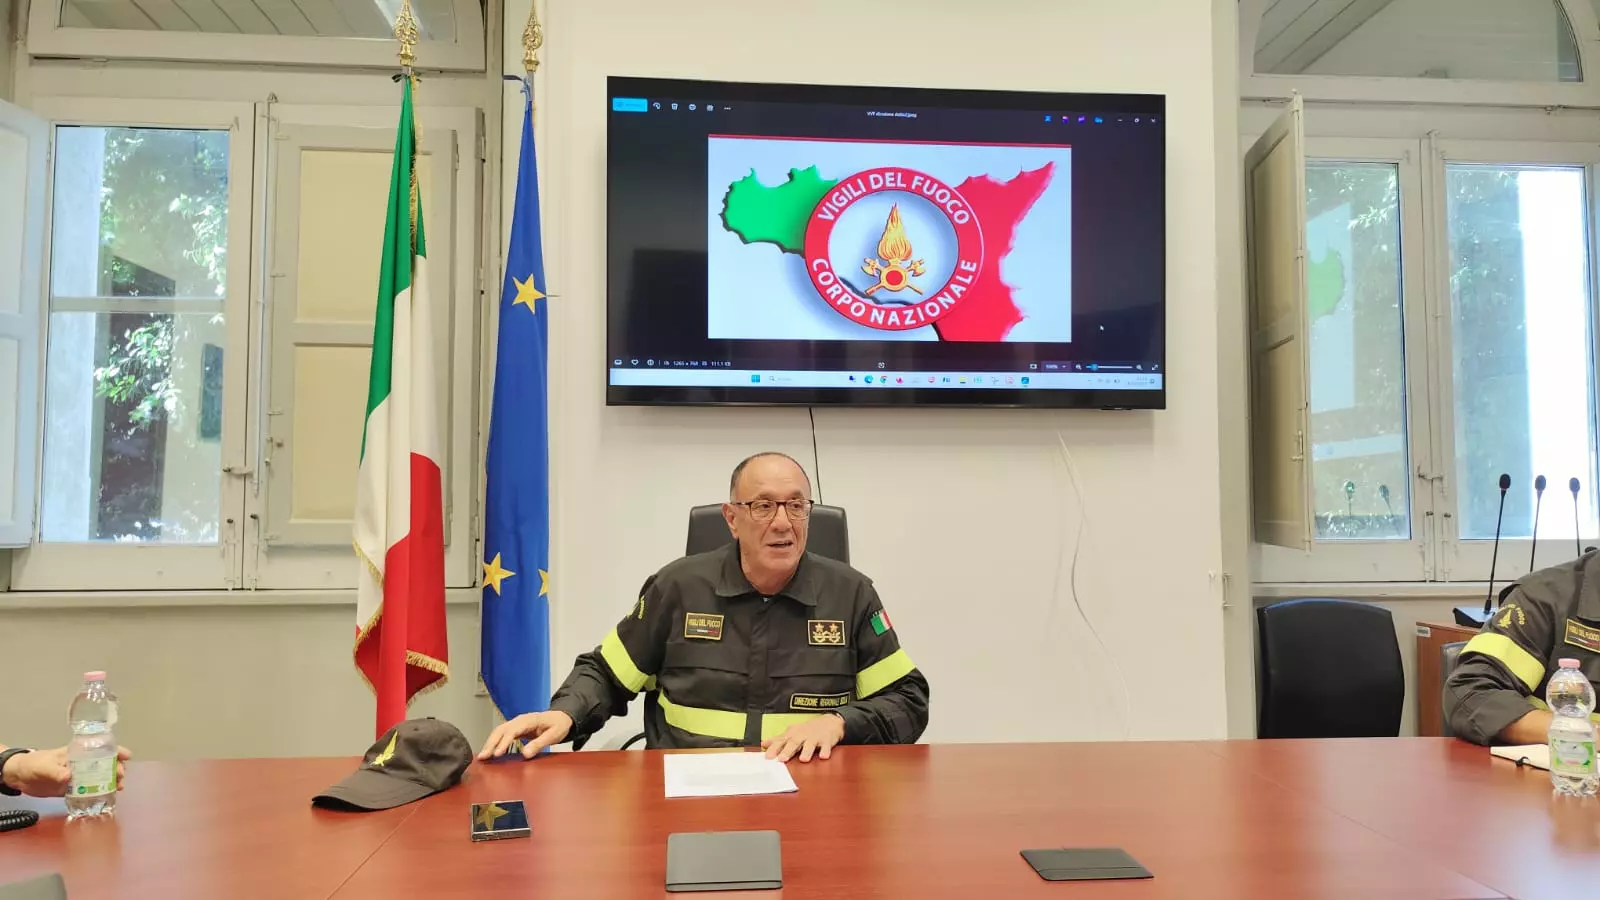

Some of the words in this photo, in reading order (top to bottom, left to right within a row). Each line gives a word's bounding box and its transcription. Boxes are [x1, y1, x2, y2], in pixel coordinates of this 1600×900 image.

[817, 178, 867, 222] VIGILI
[868, 171, 907, 189] DEL
[911, 175, 969, 225] FUOCO
[812, 258, 866, 317] CORPO
[869, 259, 977, 326] NAZIONALE
[707, 619, 721, 629] FUOCO
